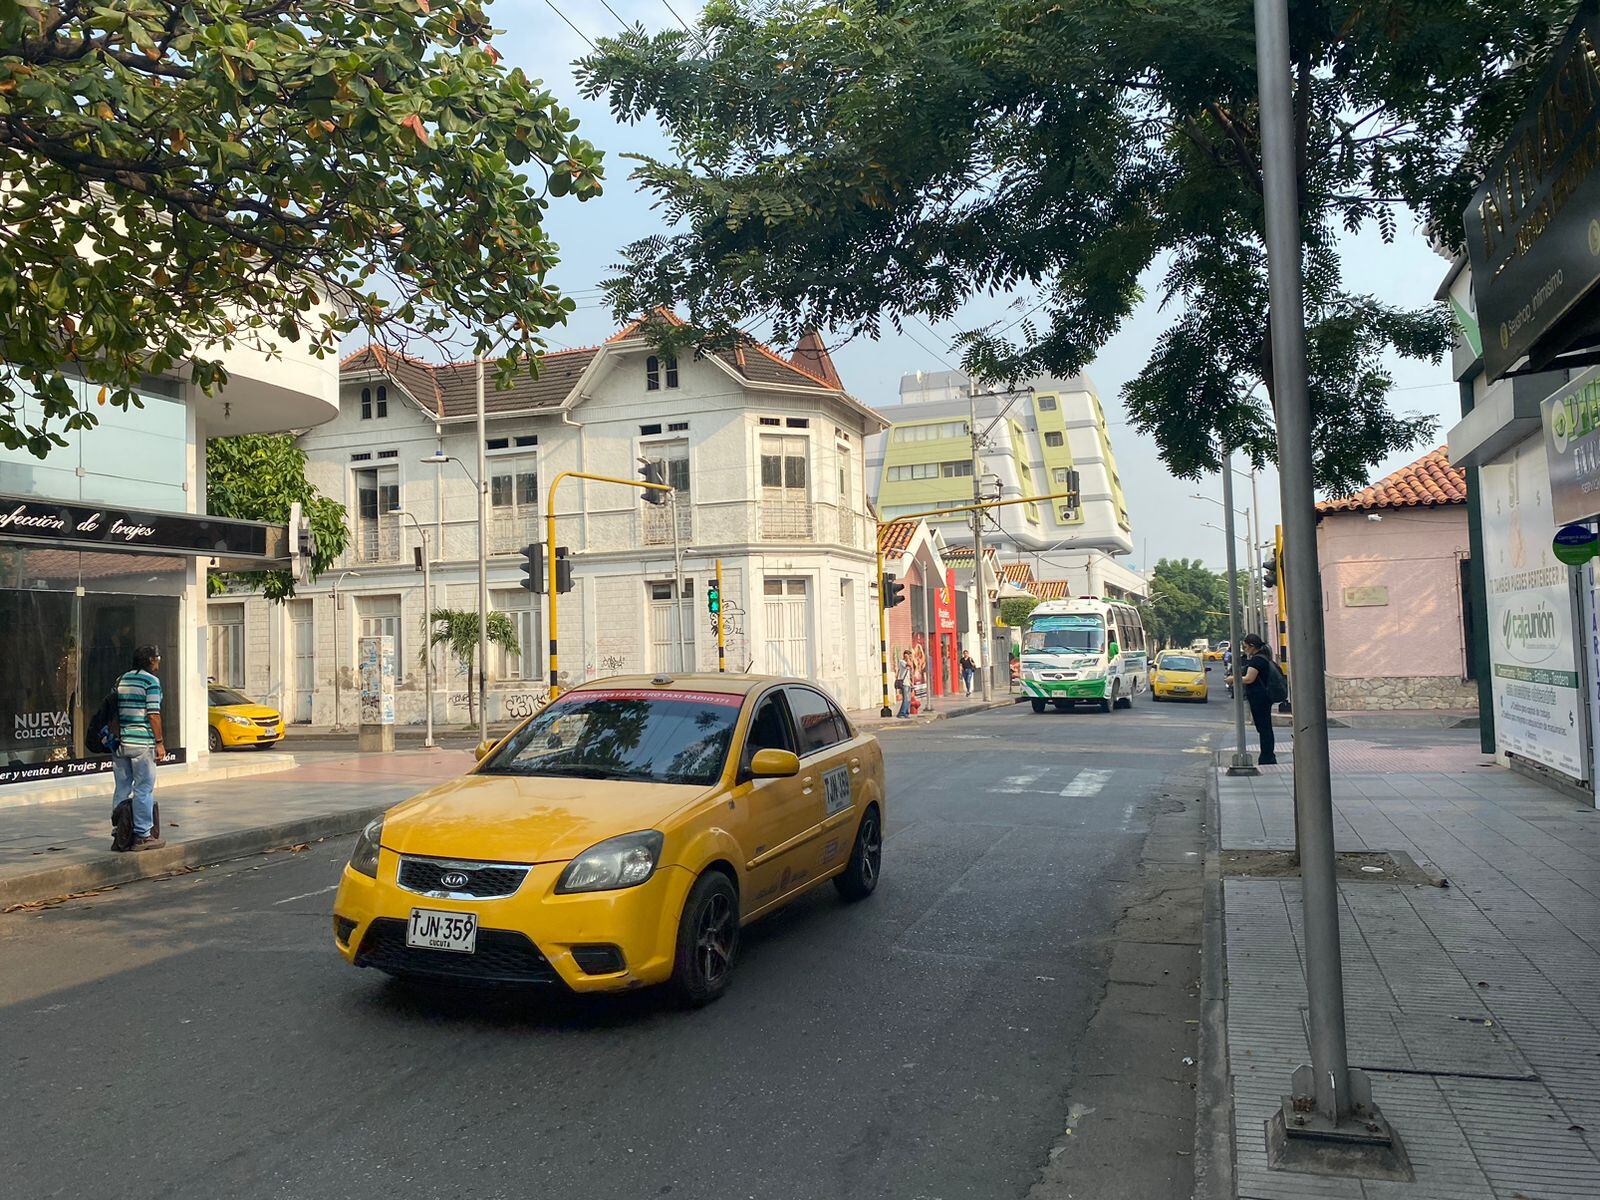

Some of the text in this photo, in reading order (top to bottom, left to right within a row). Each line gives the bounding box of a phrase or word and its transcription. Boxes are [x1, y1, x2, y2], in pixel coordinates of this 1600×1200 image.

[77, 512, 100, 532] de
[110, 518, 156, 541] trajes
[1551, 672, 1569, 686] Tendero
[15, 711, 71, 729] NUEVA
[12, 770, 20, 781] y
[22, 767, 49, 777] venta
[51, 765, 63, 775] de
[68, 761, 96, 774] Trajes
[100, 760, 113, 772] pa
[445, 875, 463, 885] KIA
[429, 939, 450, 948] CUCUTA
